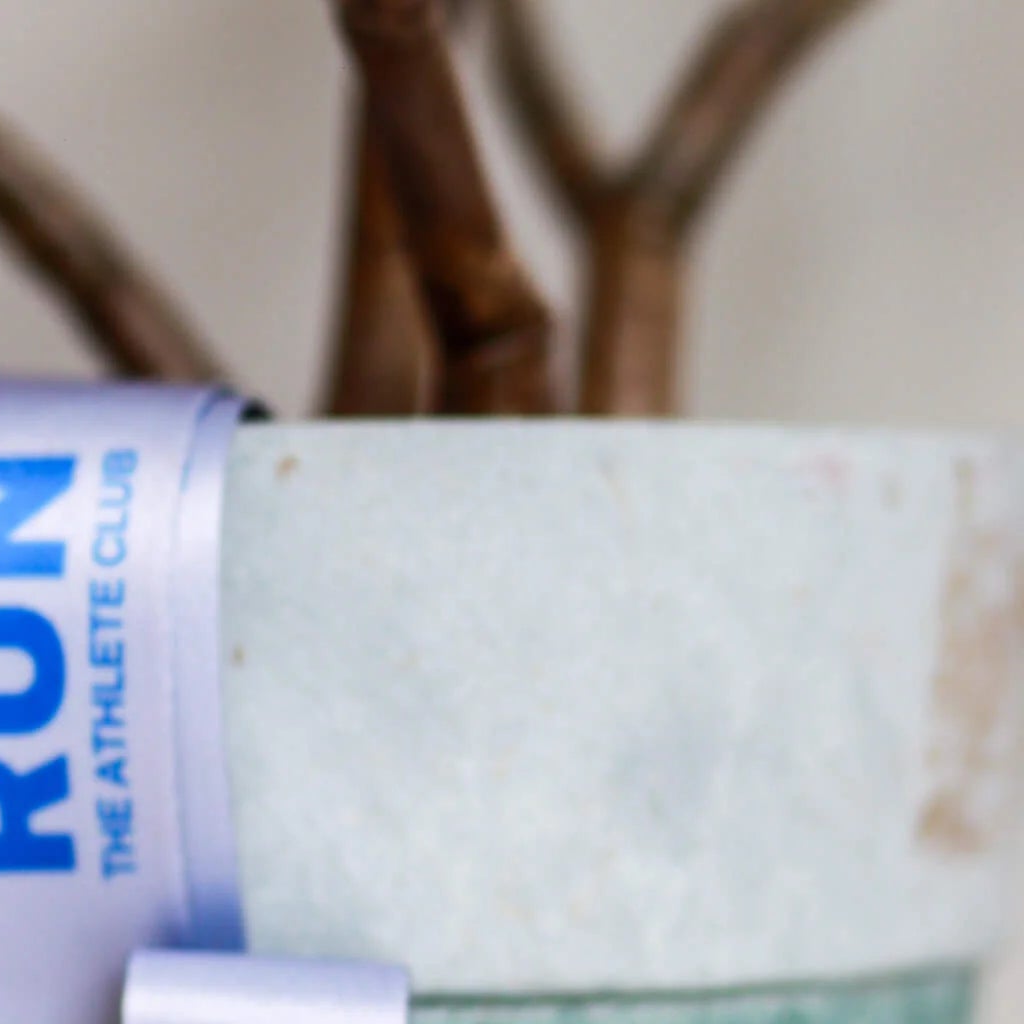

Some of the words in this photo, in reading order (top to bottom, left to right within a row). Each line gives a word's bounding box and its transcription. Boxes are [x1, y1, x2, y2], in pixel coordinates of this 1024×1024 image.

[93, 449, 138, 566] CLUB
[89, 580, 127, 786] ATHLETE
[98, 797, 137, 880] THE
